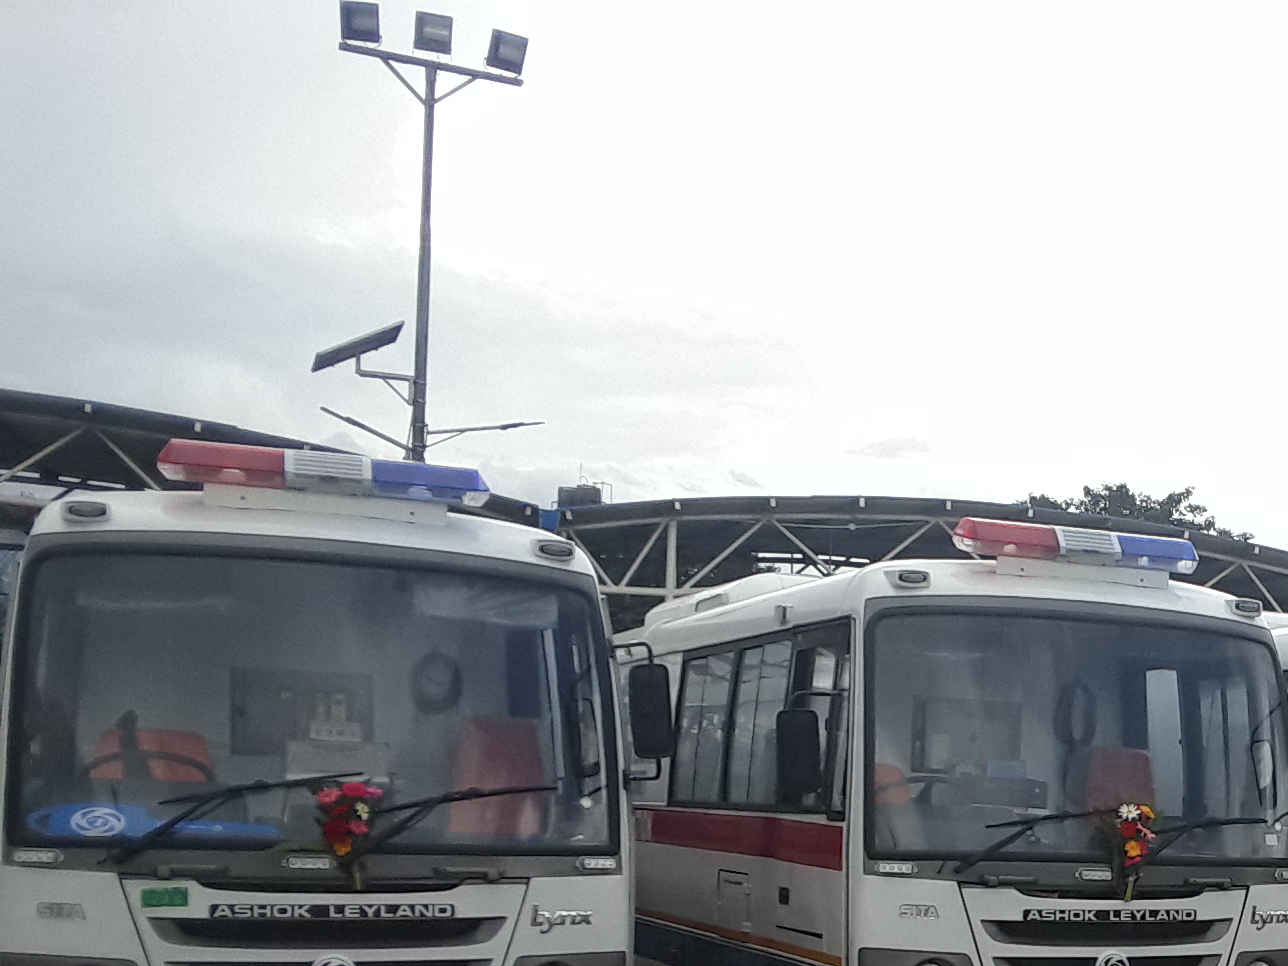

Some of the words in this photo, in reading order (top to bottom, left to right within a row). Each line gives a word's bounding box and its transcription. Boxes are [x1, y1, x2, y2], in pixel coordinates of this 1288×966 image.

[213, 904, 311, 918] ASHOK
[329, 904, 453, 918] LEYLAND
[900, 905, 938, 919] SITA
[1026, 910, 1097, 921] ASHOK
[1110, 910, 1197, 921] LEYLAND
[531, 903, 593, 934] Lynx
